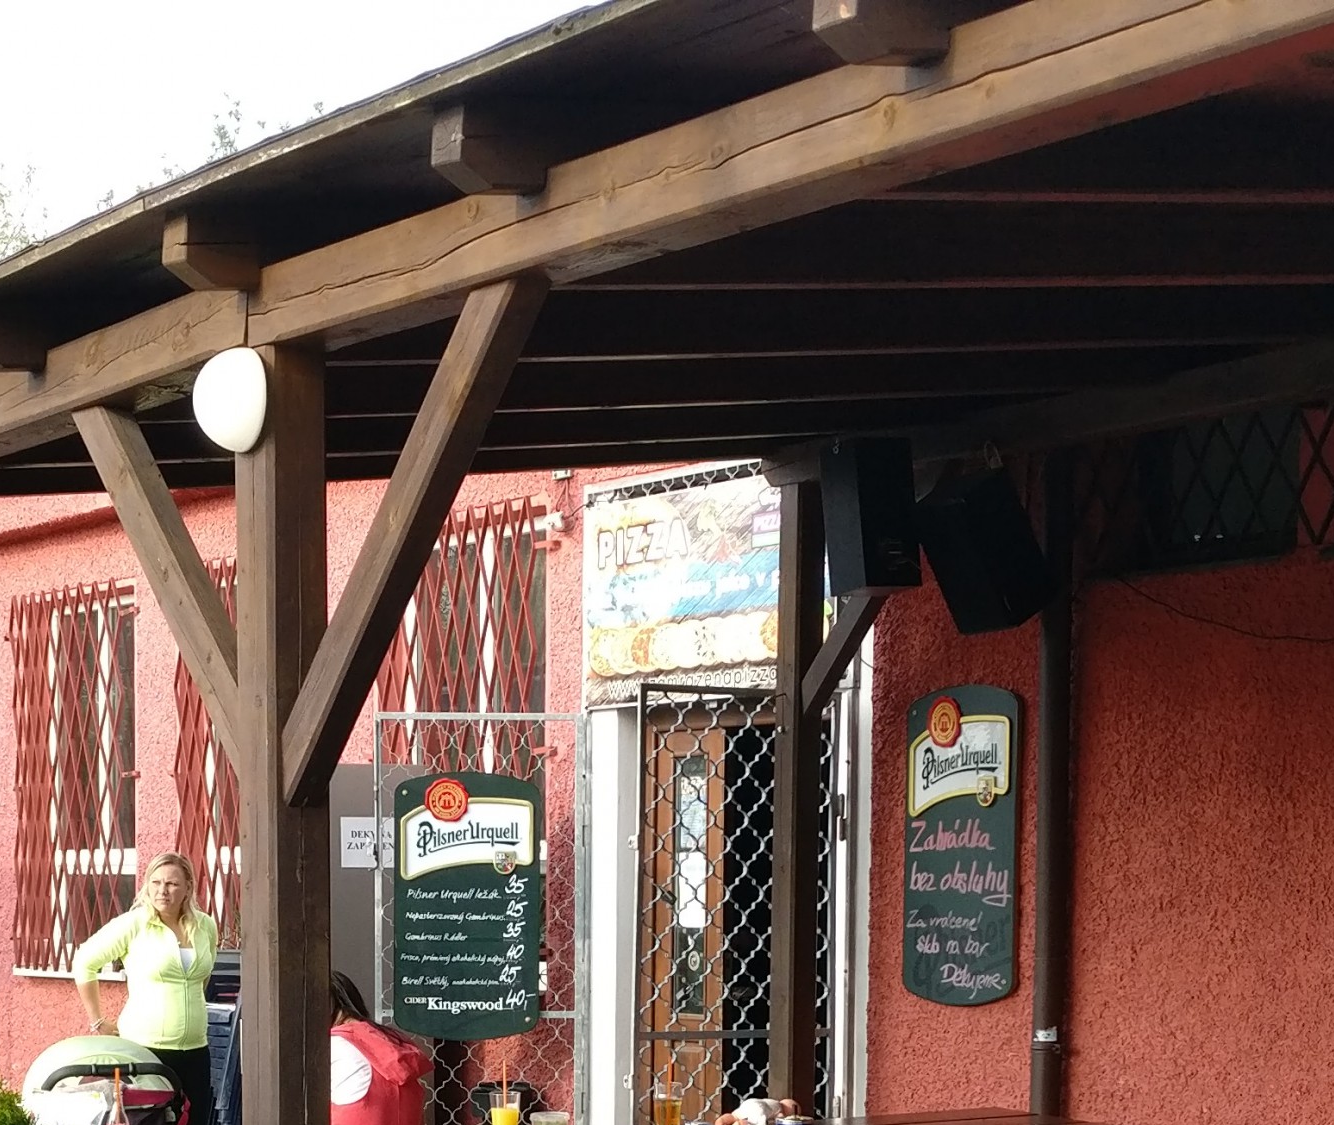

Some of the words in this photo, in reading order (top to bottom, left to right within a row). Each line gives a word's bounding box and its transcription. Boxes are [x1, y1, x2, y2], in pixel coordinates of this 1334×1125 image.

[597, 516, 690, 569] PIZZA
[921, 746, 961, 790] Pilsner
[960, 742, 998, 774] Urquell
[416, 820, 469, 857] Pilsner
[468, 819, 518, 847] Urquell
[440, 888, 474, 903] Urquell
[909, 860, 937, 891] bez
[939, 860, 1012, 907] obsluhy
[964, 935, 990, 957] bar
[427, 996, 503, 1014] Kingswood
